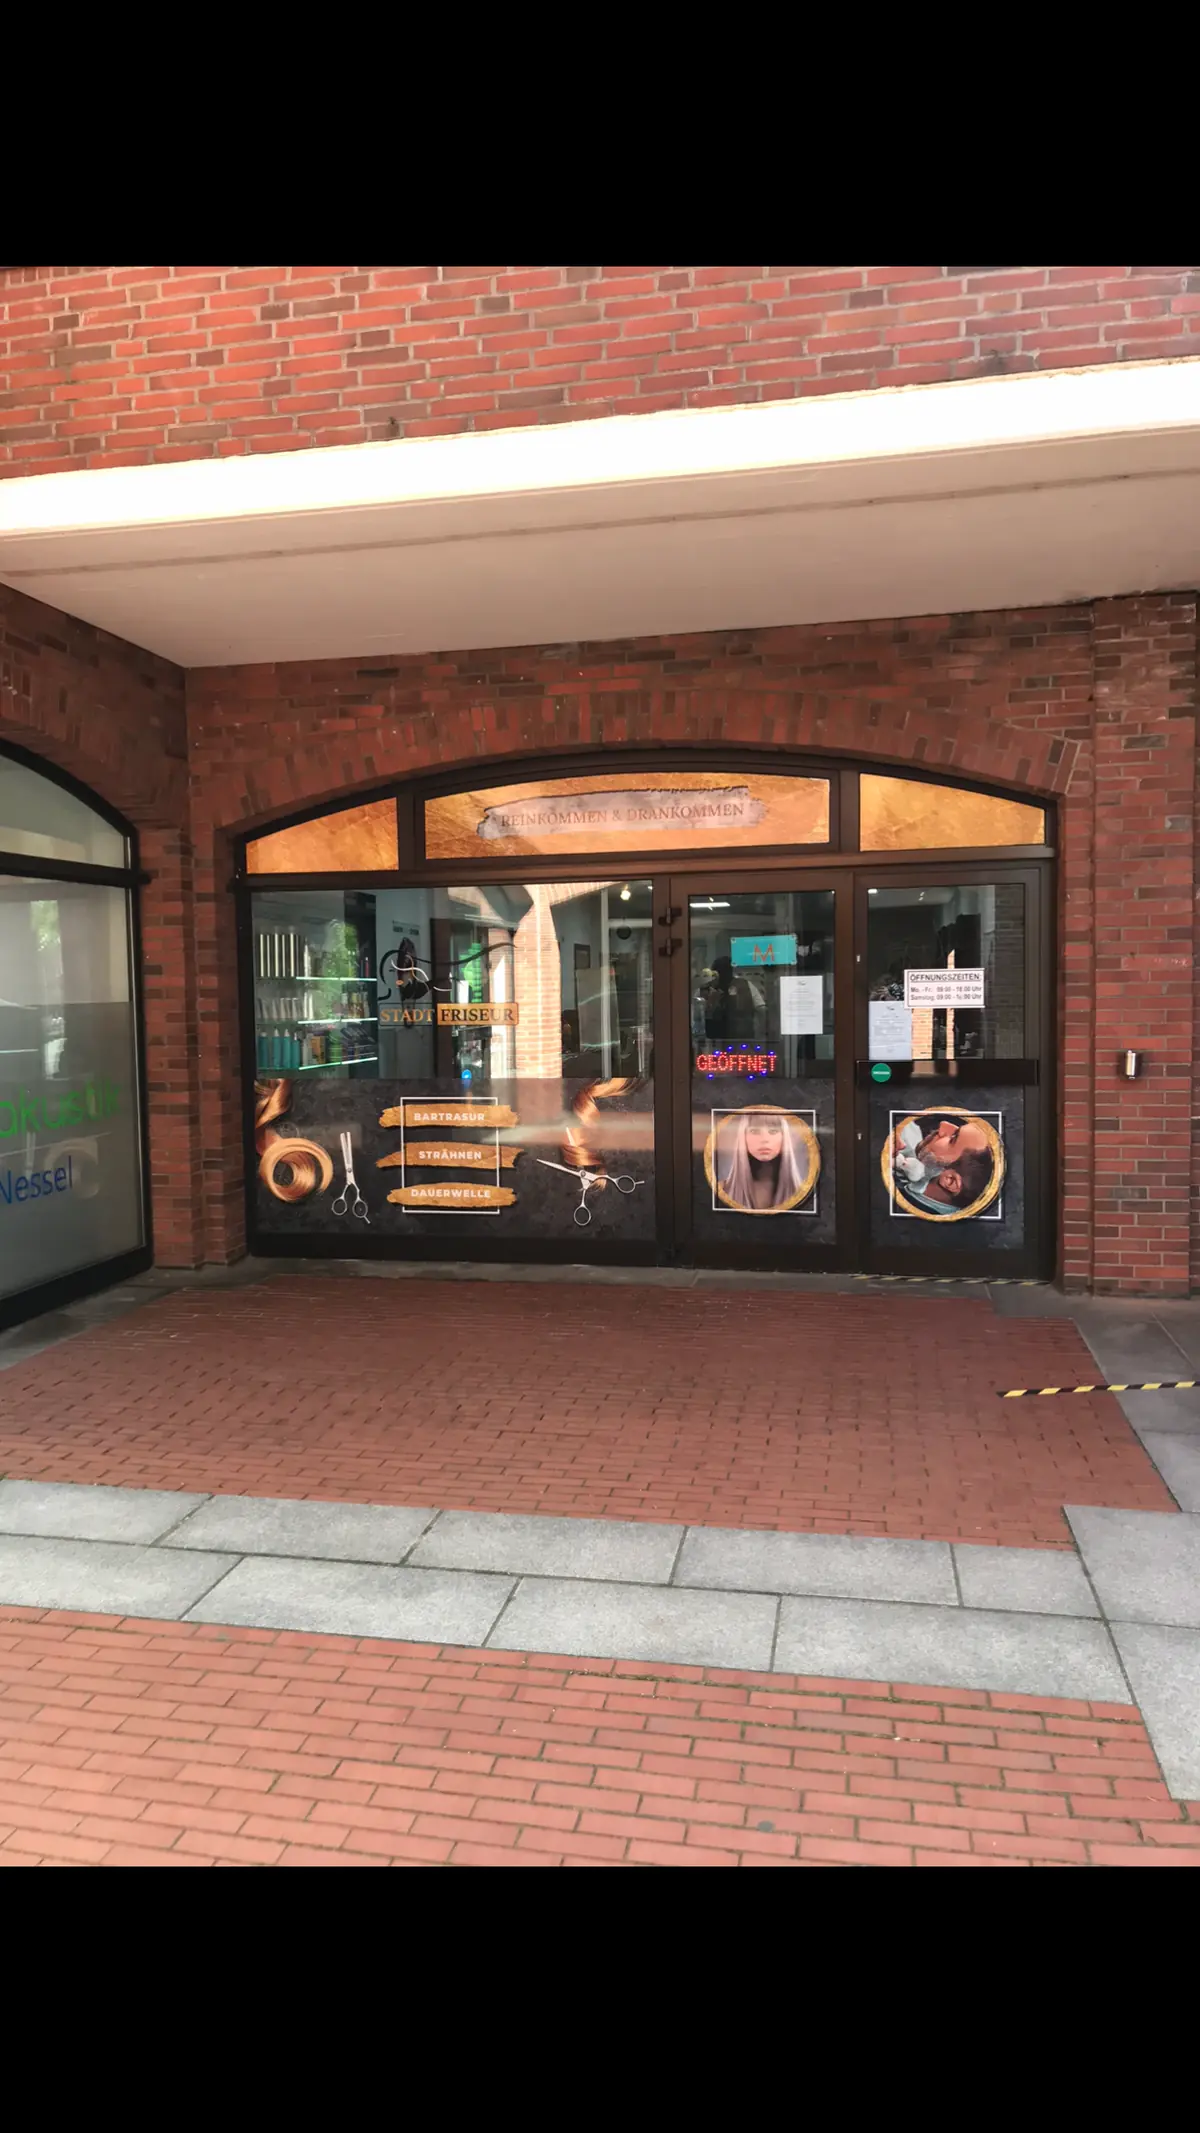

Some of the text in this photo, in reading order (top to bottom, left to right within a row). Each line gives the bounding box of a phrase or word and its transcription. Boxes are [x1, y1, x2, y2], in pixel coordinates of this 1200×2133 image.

[501, 803, 745, 827] REINKOMMEN & DRANKOMMEN
[380, 1008, 514, 1022] STADT FRISEUR
[696, 1052, 777, 1072] GEÖFFNET
[414, 1112, 485, 1121] BARTRASUR
[418, 1149, 482, 1159] STRÄHNEN
[411, 1188, 491, 1199] DAUERWELLE
